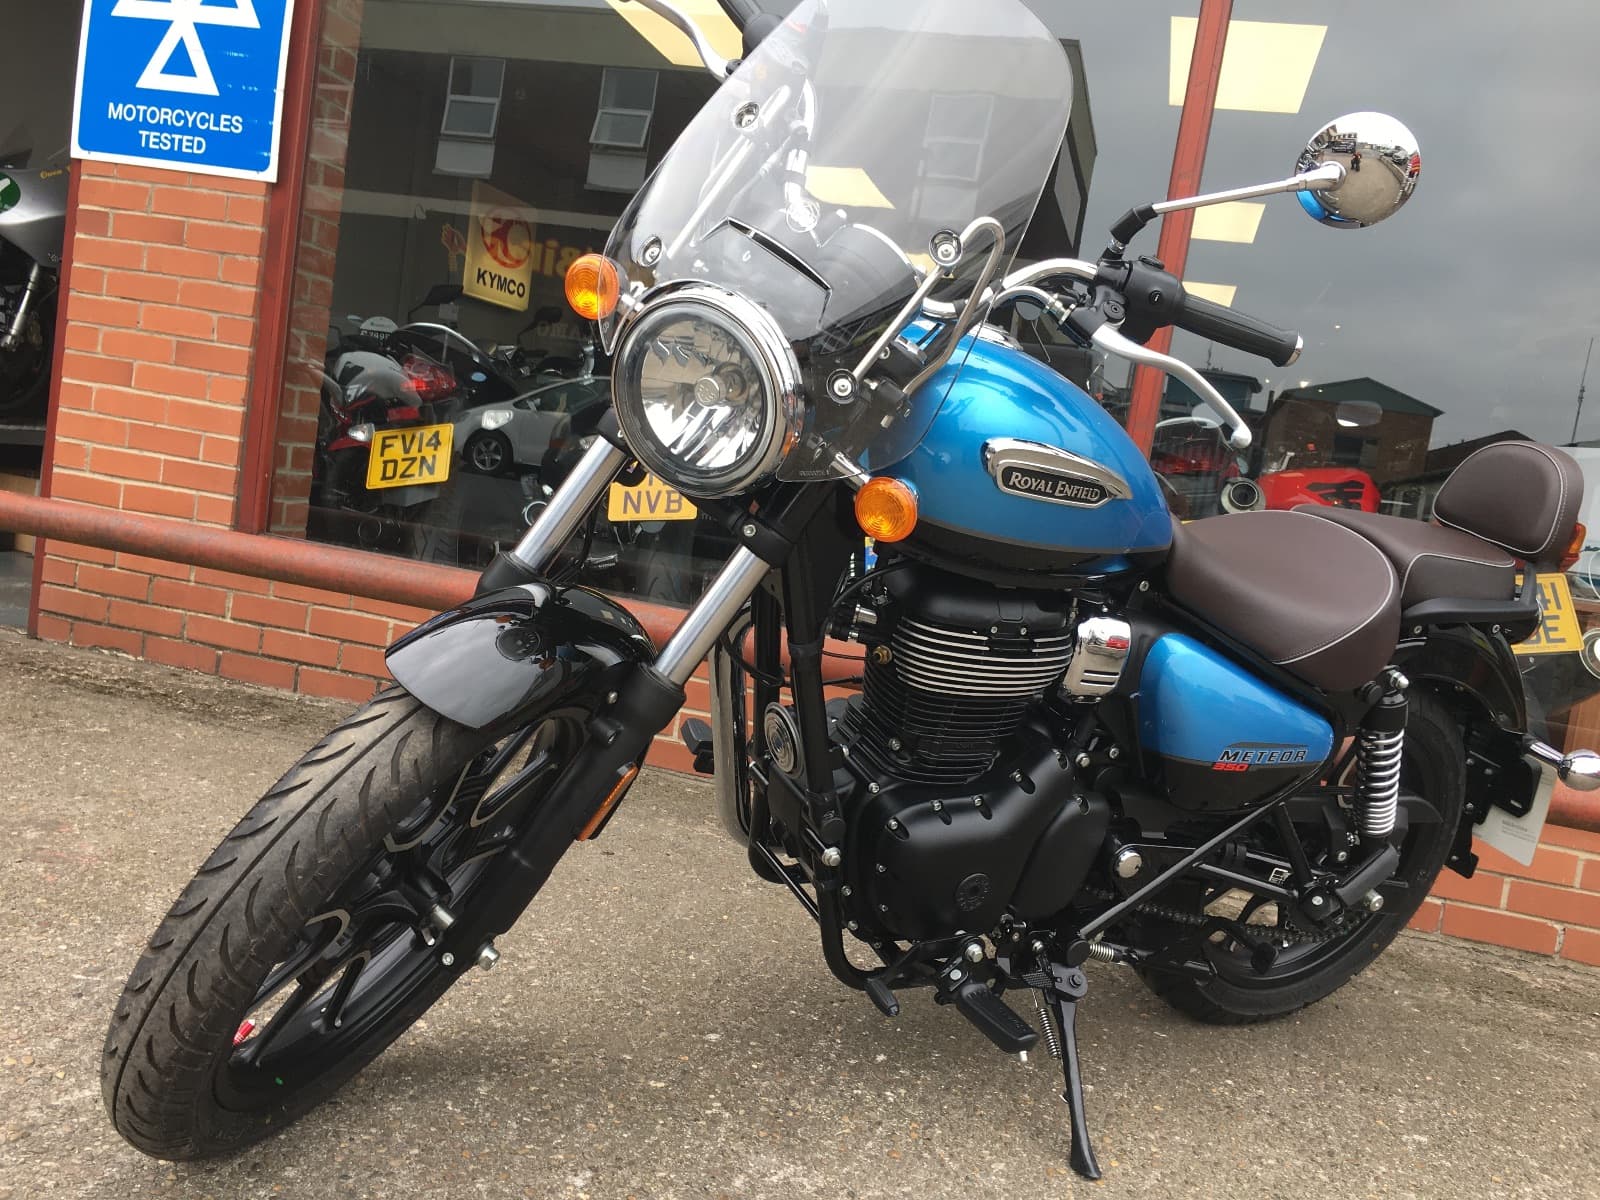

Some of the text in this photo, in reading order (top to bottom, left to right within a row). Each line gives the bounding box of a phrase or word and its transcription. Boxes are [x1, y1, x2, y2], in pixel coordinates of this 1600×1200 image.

[108, 102, 243, 134] MOTORCYCLES
[139, 130, 206, 154] TESTED
[477, 268, 526, 298] KYMCO
[380, 430, 441, 457] FV14
[380, 455, 436, 481] DZN
[1008, 471, 1101, 501] ROYAL ENFIELD
[623, 490, 683, 515] NVB
[1219, 749, 1308, 764] METEOR
